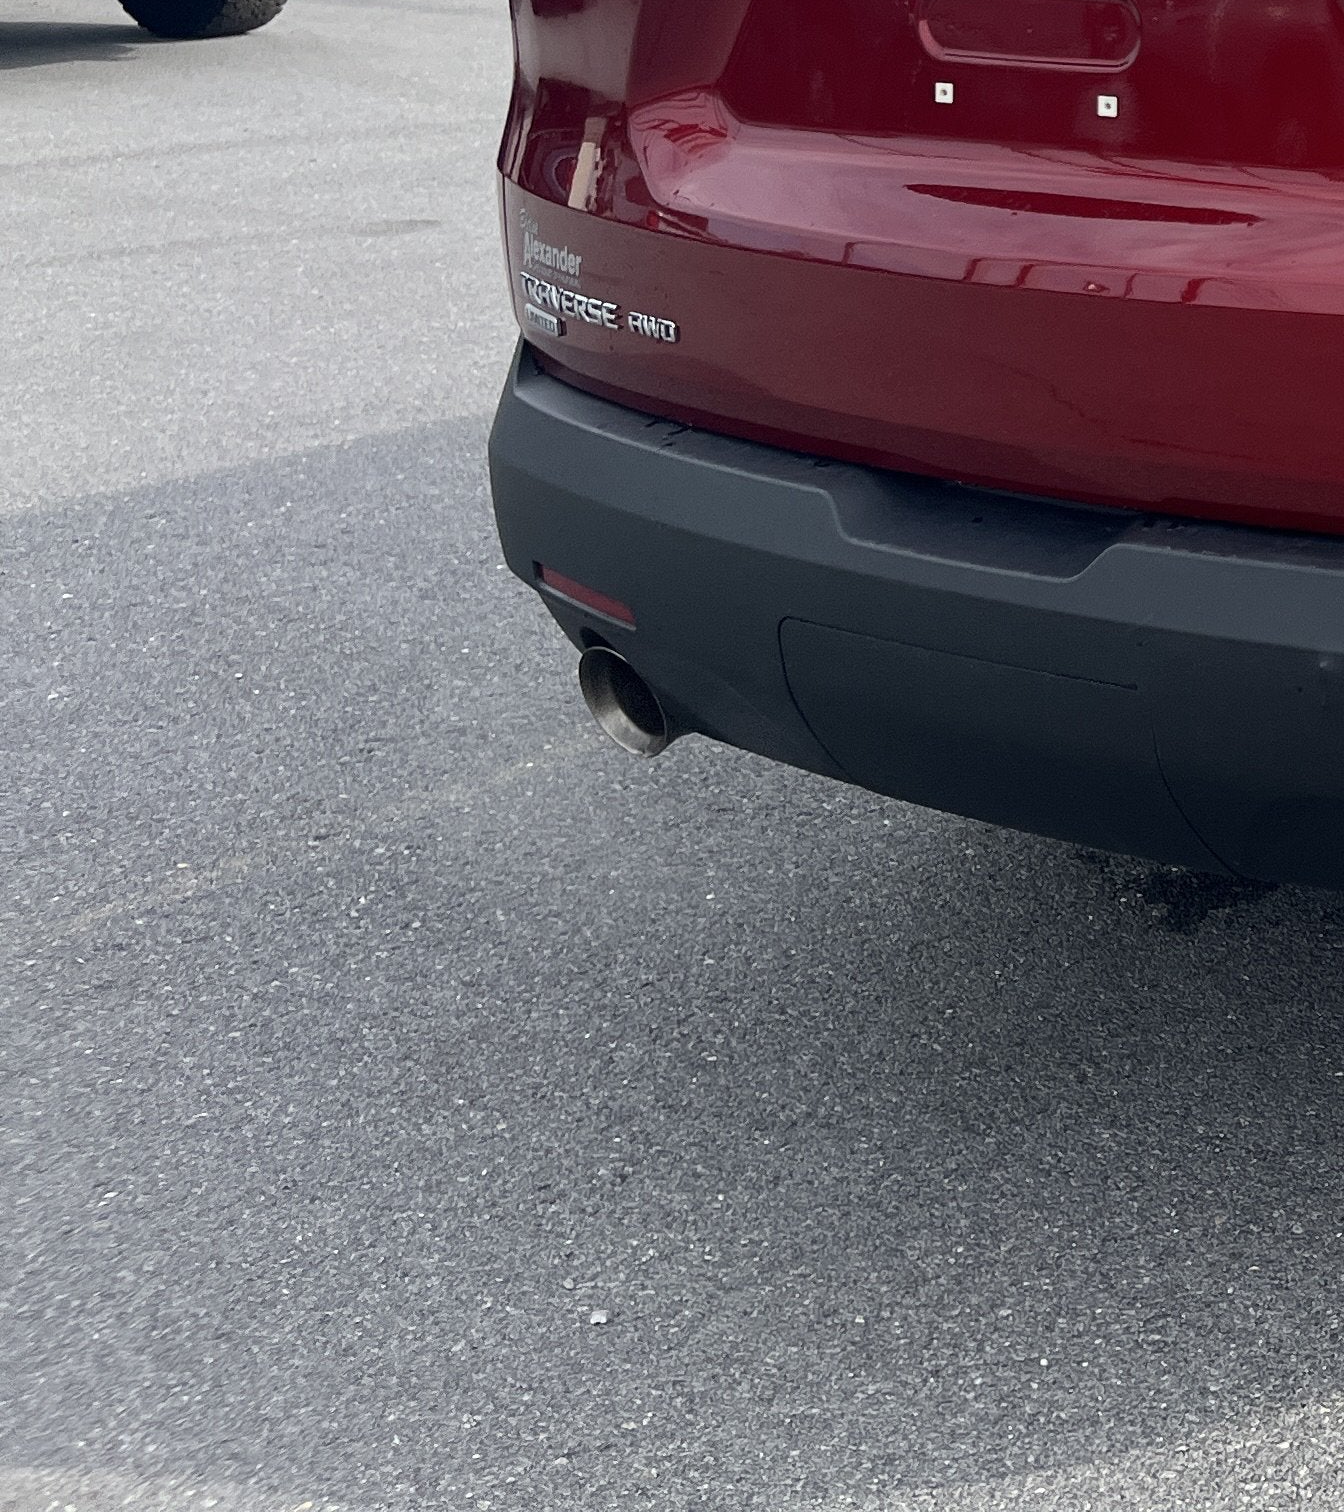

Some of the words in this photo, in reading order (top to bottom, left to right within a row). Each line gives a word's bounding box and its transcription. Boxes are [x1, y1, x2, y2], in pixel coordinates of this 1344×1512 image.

[523, 231, 583, 277] Alexander
[520, 271, 620, 330] TRAVERSE
[627, 311, 679, 344] AWD
